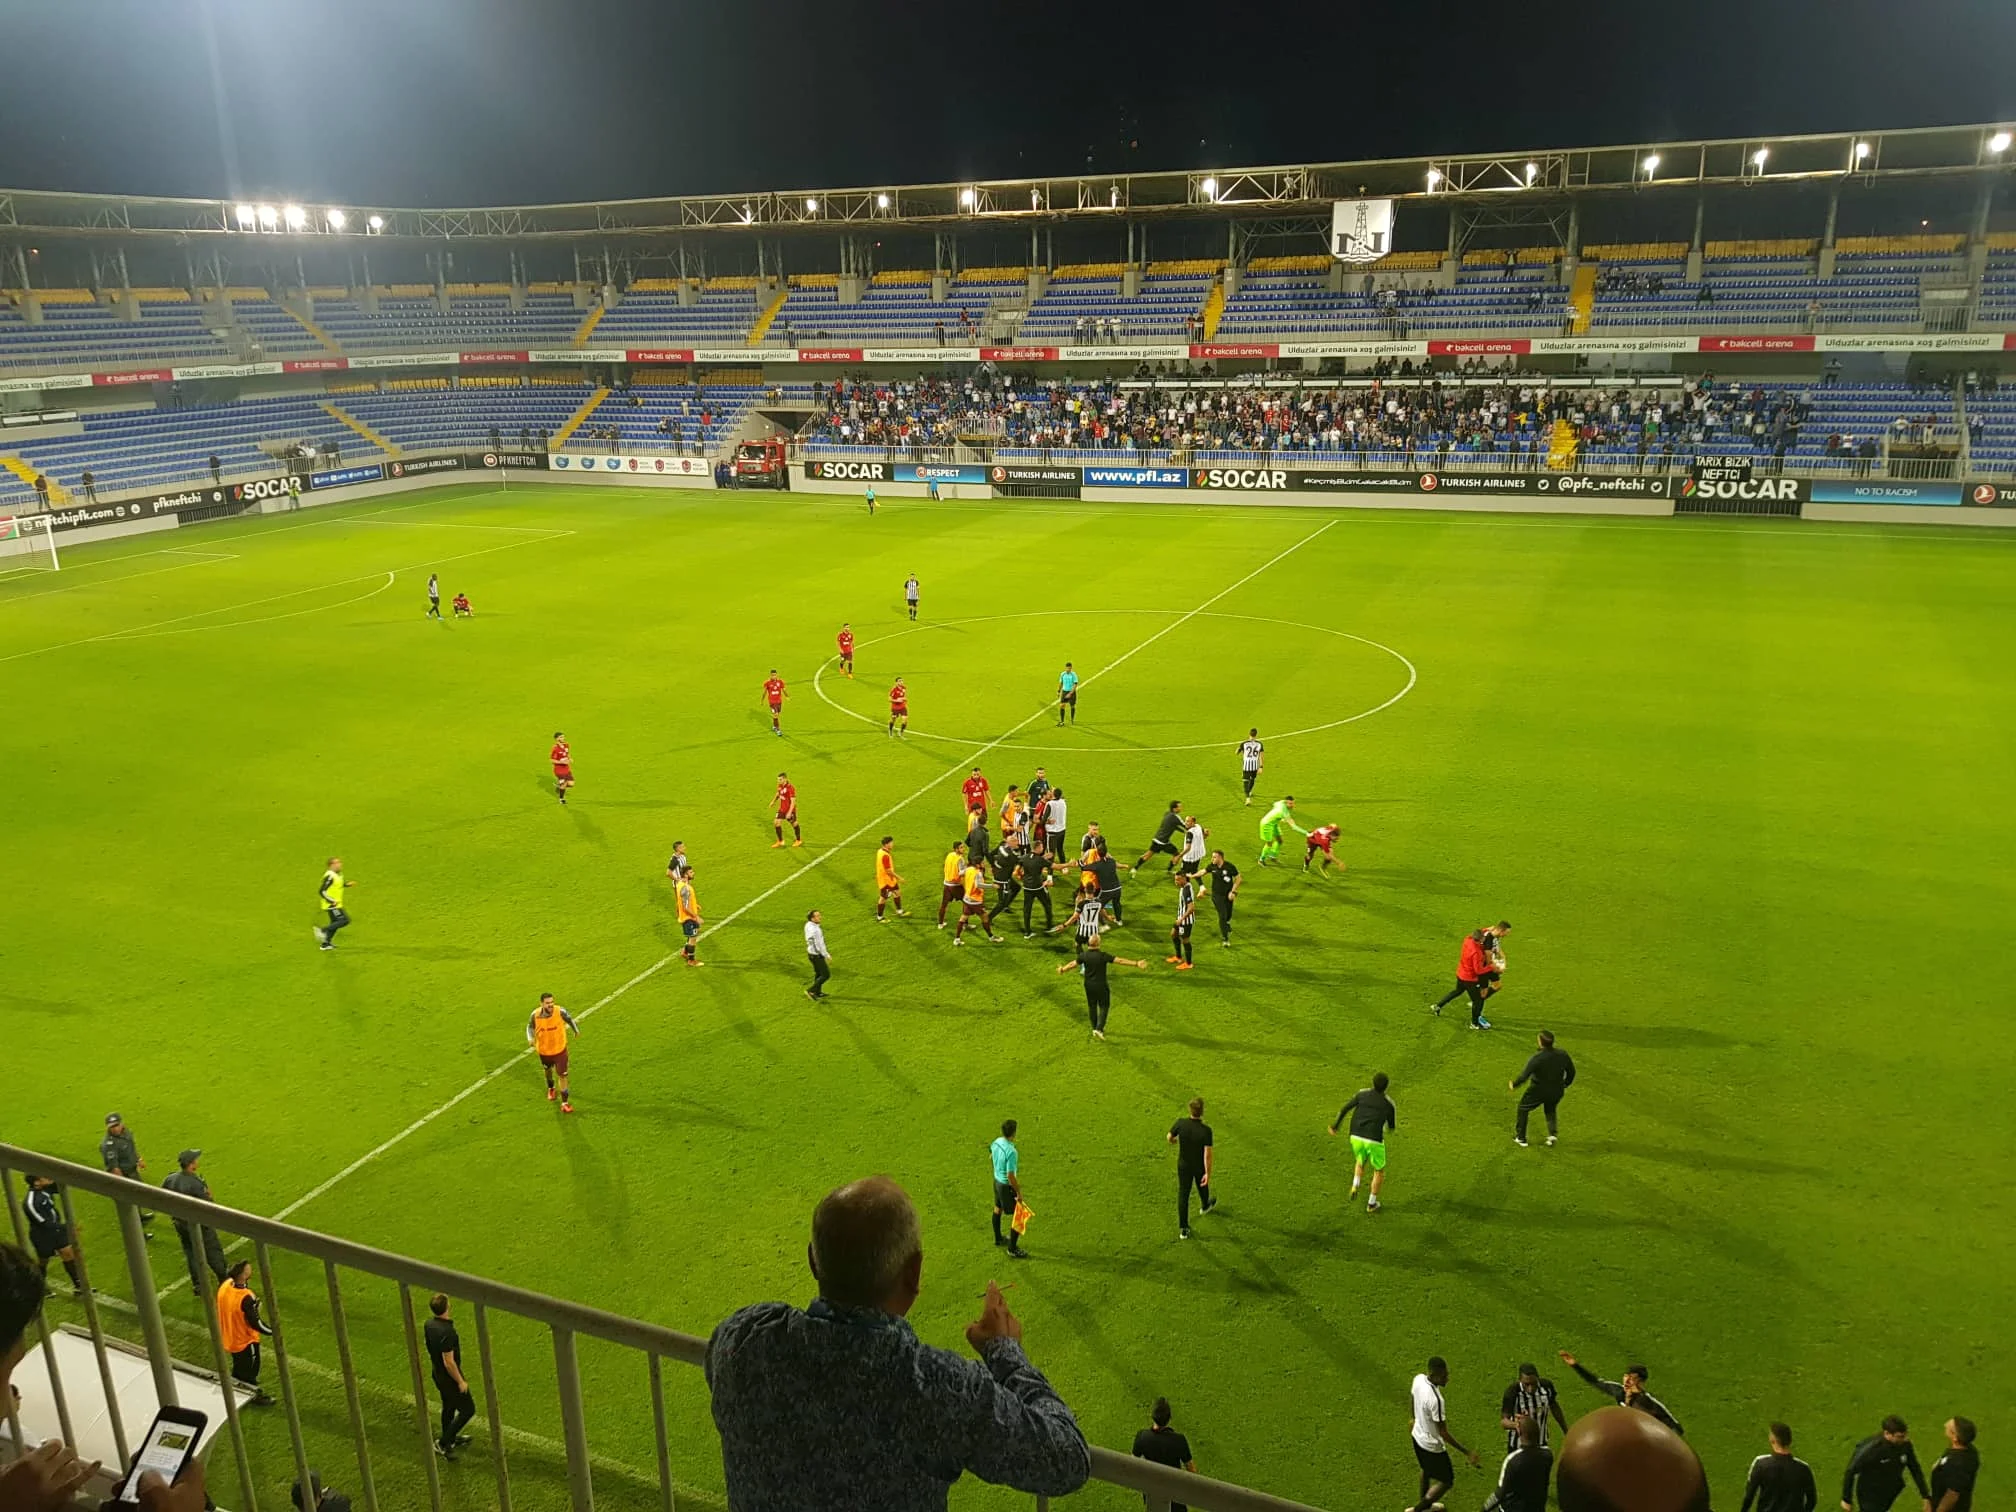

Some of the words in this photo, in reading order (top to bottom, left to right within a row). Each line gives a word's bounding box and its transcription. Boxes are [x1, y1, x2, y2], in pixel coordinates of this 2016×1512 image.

[404, 462, 428, 471] TURKISH
[429, 459, 457, 467] AIRLINES
[823, 463, 883, 479] SOCAR
[927, 469, 959, 477] RESPECT
[1008, 471, 1040, 479] TURKISH
[1042, 471, 1075, 479] AIRLINES
[1090, 470, 1181, 484] www.pfl.az
[1209, 470, 1287, 488] SOCAR
[244, 477, 301, 499] SOCAR
[1440, 479, 1480, 487] TURKISH
[1483, 480, 1525, 488] AIRLINES
[1558, 476, 1645, 492] @pfc_neftchi
[1697, 479, 1798, 499] SOCAR
[1854, 487, 1870, 495] NO
[1885, 488, 1918, 496] RACISM
[153, 492, 202, 512] pfkneftchi
[1246, 746, 1258, 758] 26
[1087, 908, 1099, 922] 17
